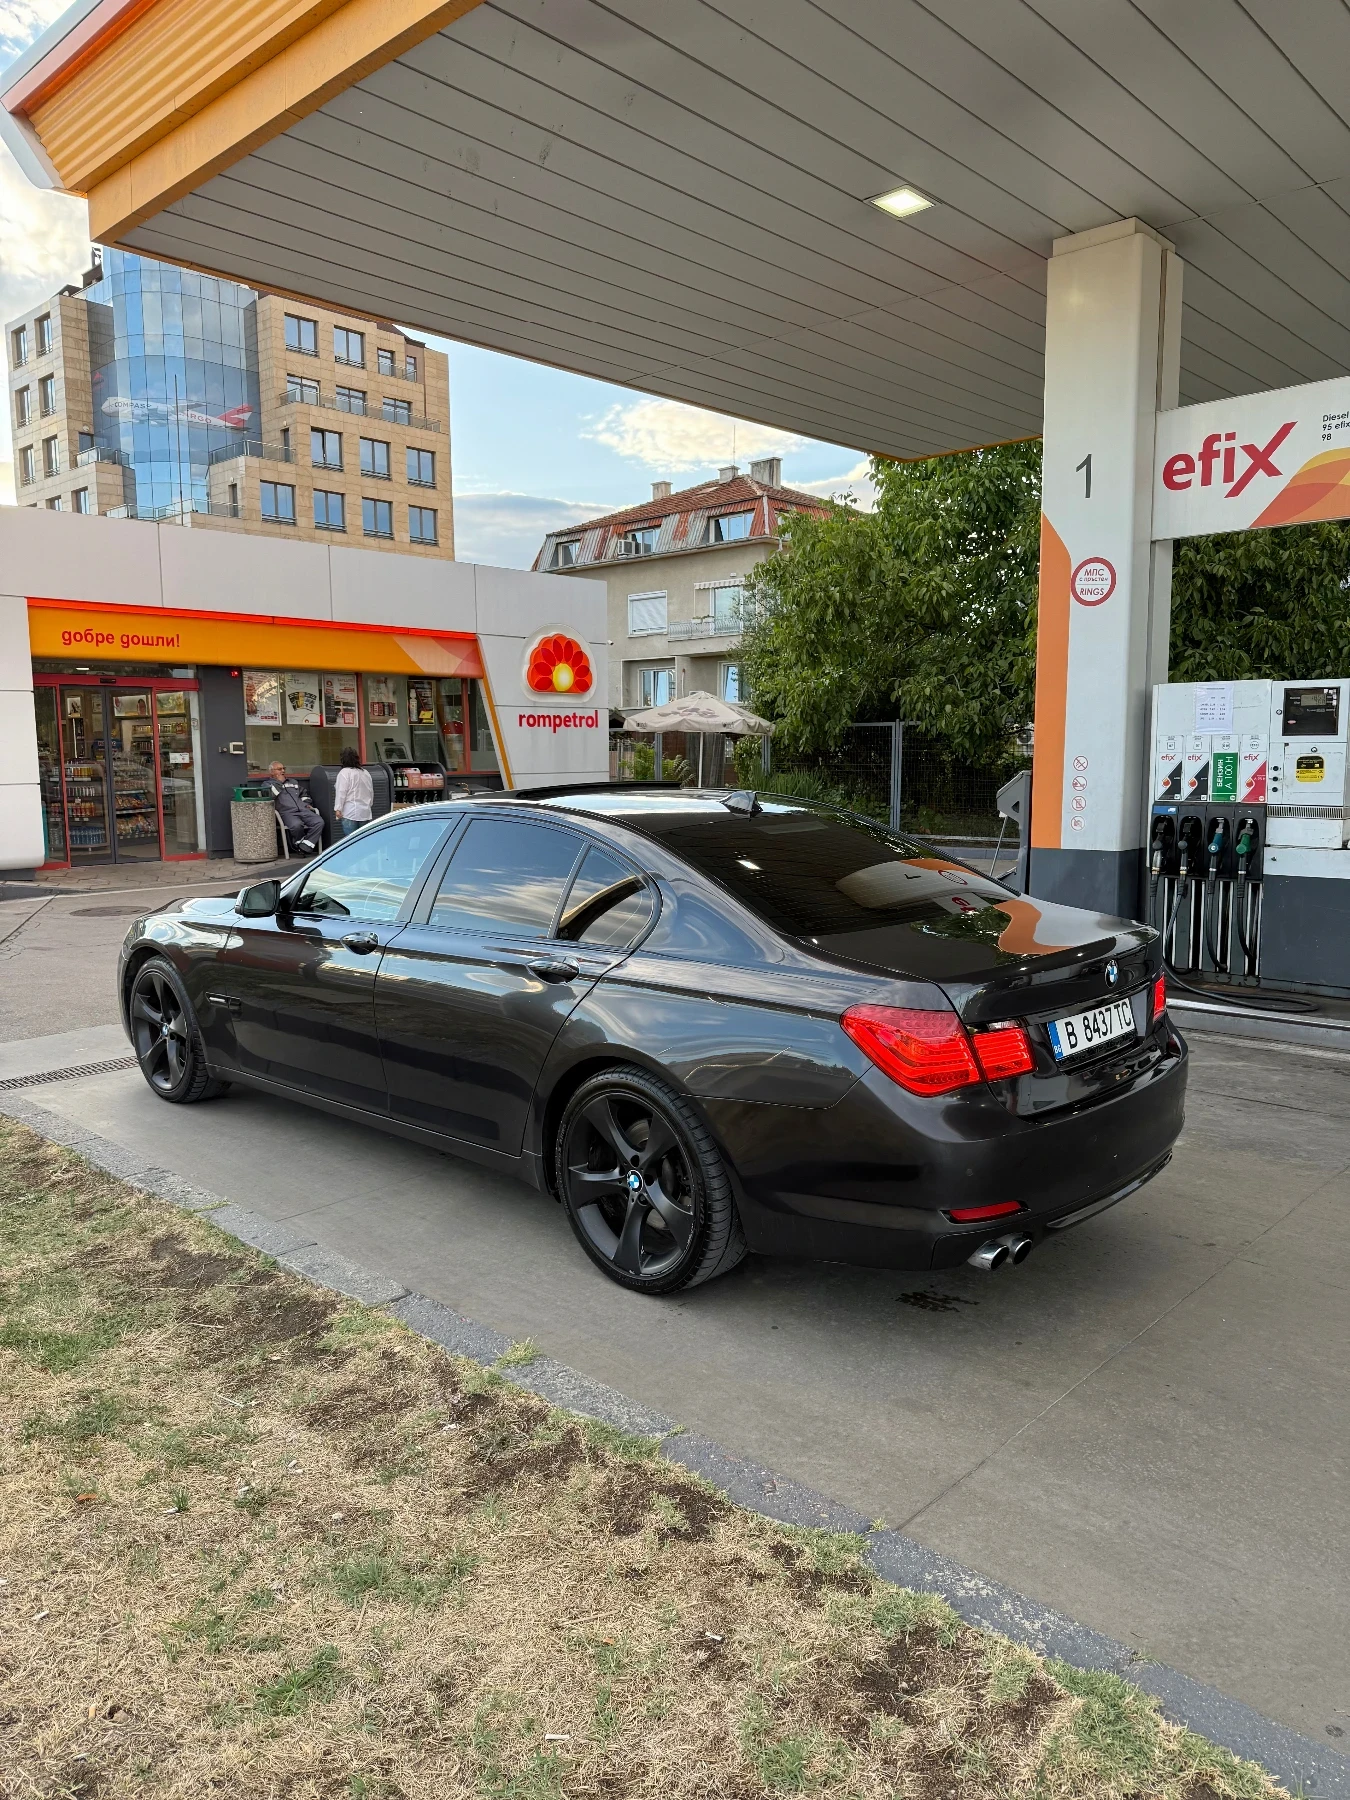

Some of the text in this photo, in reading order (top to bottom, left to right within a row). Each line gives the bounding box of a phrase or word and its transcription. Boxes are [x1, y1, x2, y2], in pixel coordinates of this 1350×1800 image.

[1323, 411, 1349, 422] Diesel
[1322, 423, 1332, 431] 95
[1322, 433, 1332, 441] 98
[1163, 421, 1298, 499] efix
[1076, 454, 1092, 498] 1
[1084, 568, 1105, 577] МПС
[61, 628, 180, 649] добре дошли!
[518, 709, 599, 733] rompetrol
[1161, 753, 1176, 762] efix
[1187, 754, 1203, 762] efix
[1243, 753, 1260, 761] efix
[1216, 759, 1224, 787] БЕНЗИН
[1225, 764, 1233, 779] 100
[1064, 1001, 1132, 1049] B 8437 TC
